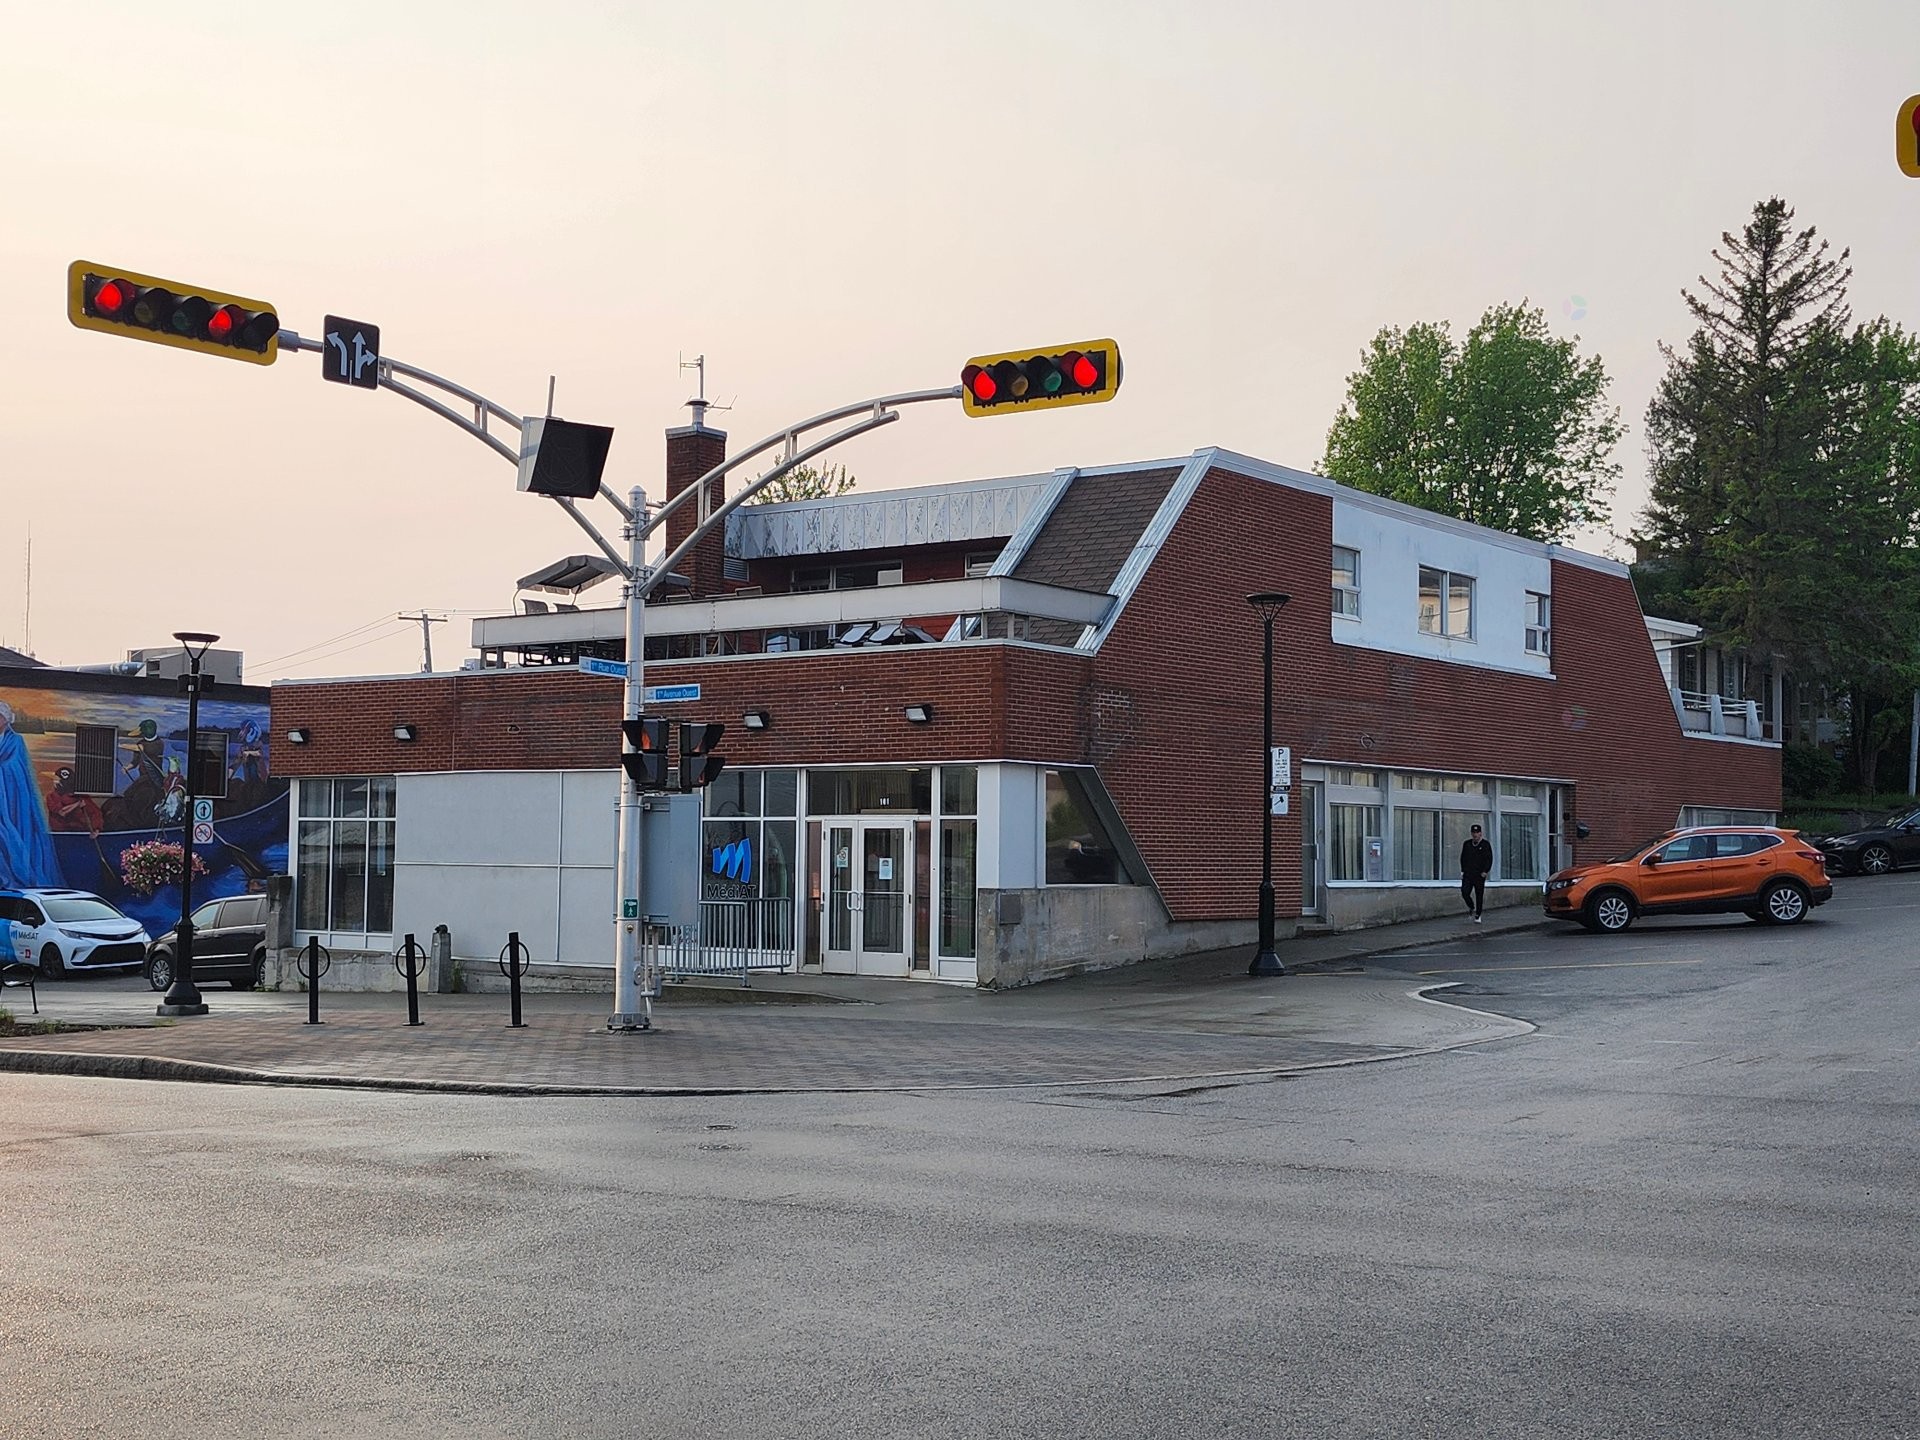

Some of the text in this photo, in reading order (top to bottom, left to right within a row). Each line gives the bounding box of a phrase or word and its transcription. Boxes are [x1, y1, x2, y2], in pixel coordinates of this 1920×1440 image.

[598, 662, 609, 673] Rue
[610, 664, 626, 676] Ouest
[664, 689, 682, 698] Avenue
[682, 688, 697, 697] Ouest
[1278, 748, 1284, 758] P
[707, 882, 757, 899] MédiAT
